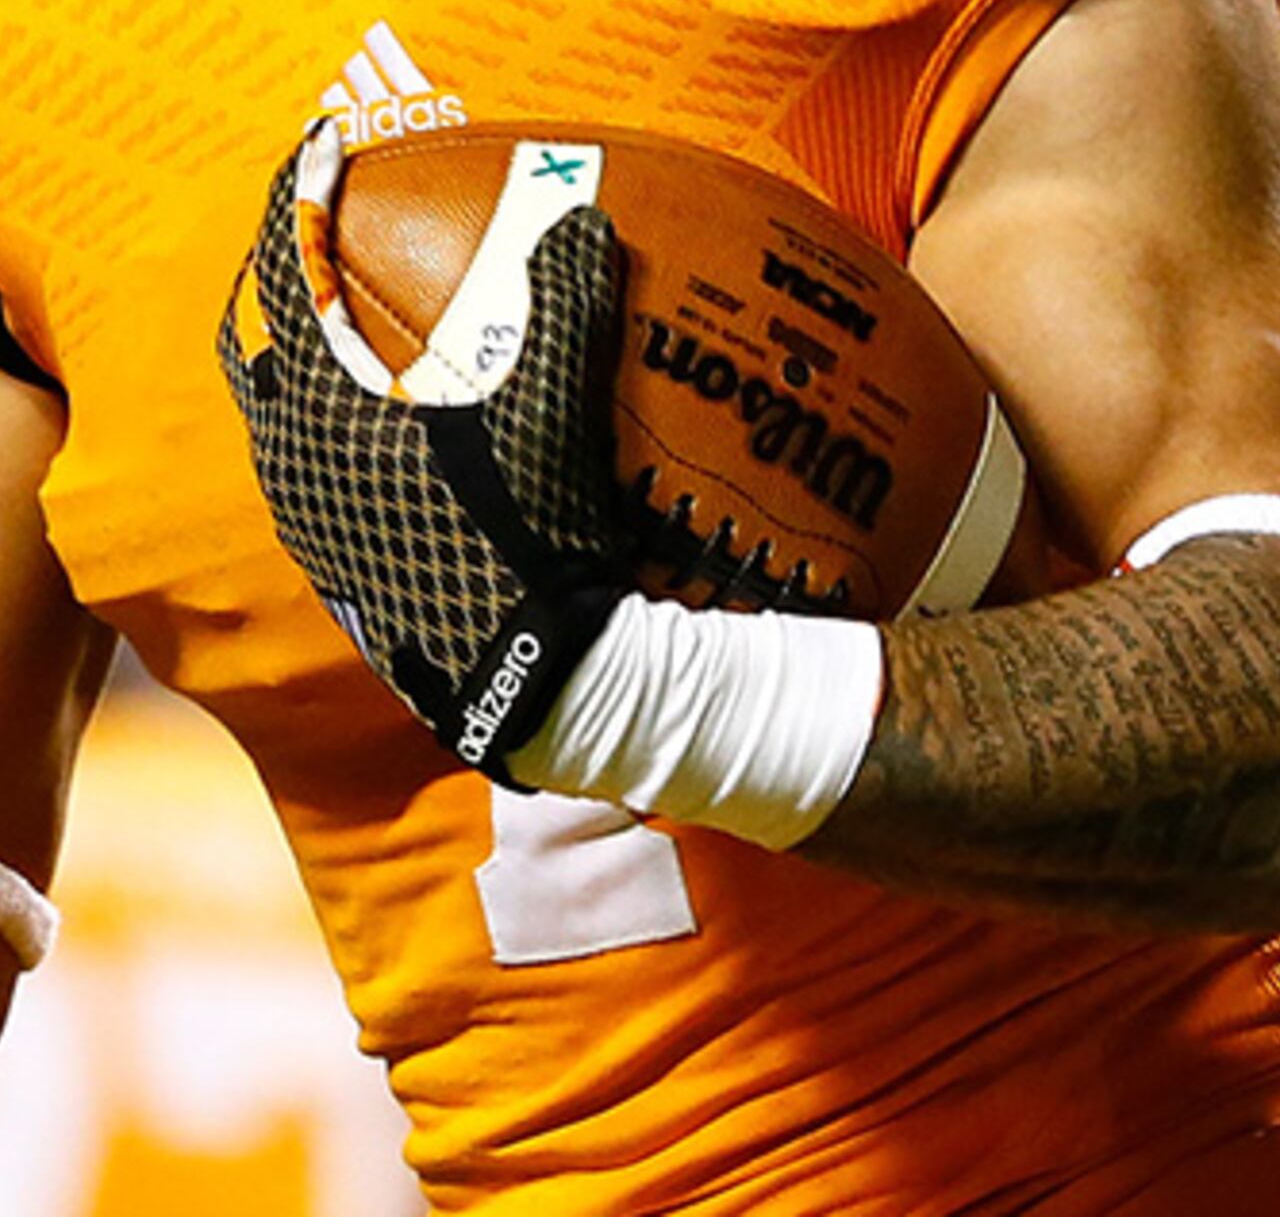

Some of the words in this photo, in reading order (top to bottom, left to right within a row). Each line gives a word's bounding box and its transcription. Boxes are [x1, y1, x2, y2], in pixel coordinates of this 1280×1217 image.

[303, 94, 468, 144] didas
[641, 319, 894, 533] Wilson
[455, 632, 542, 765] adizero
